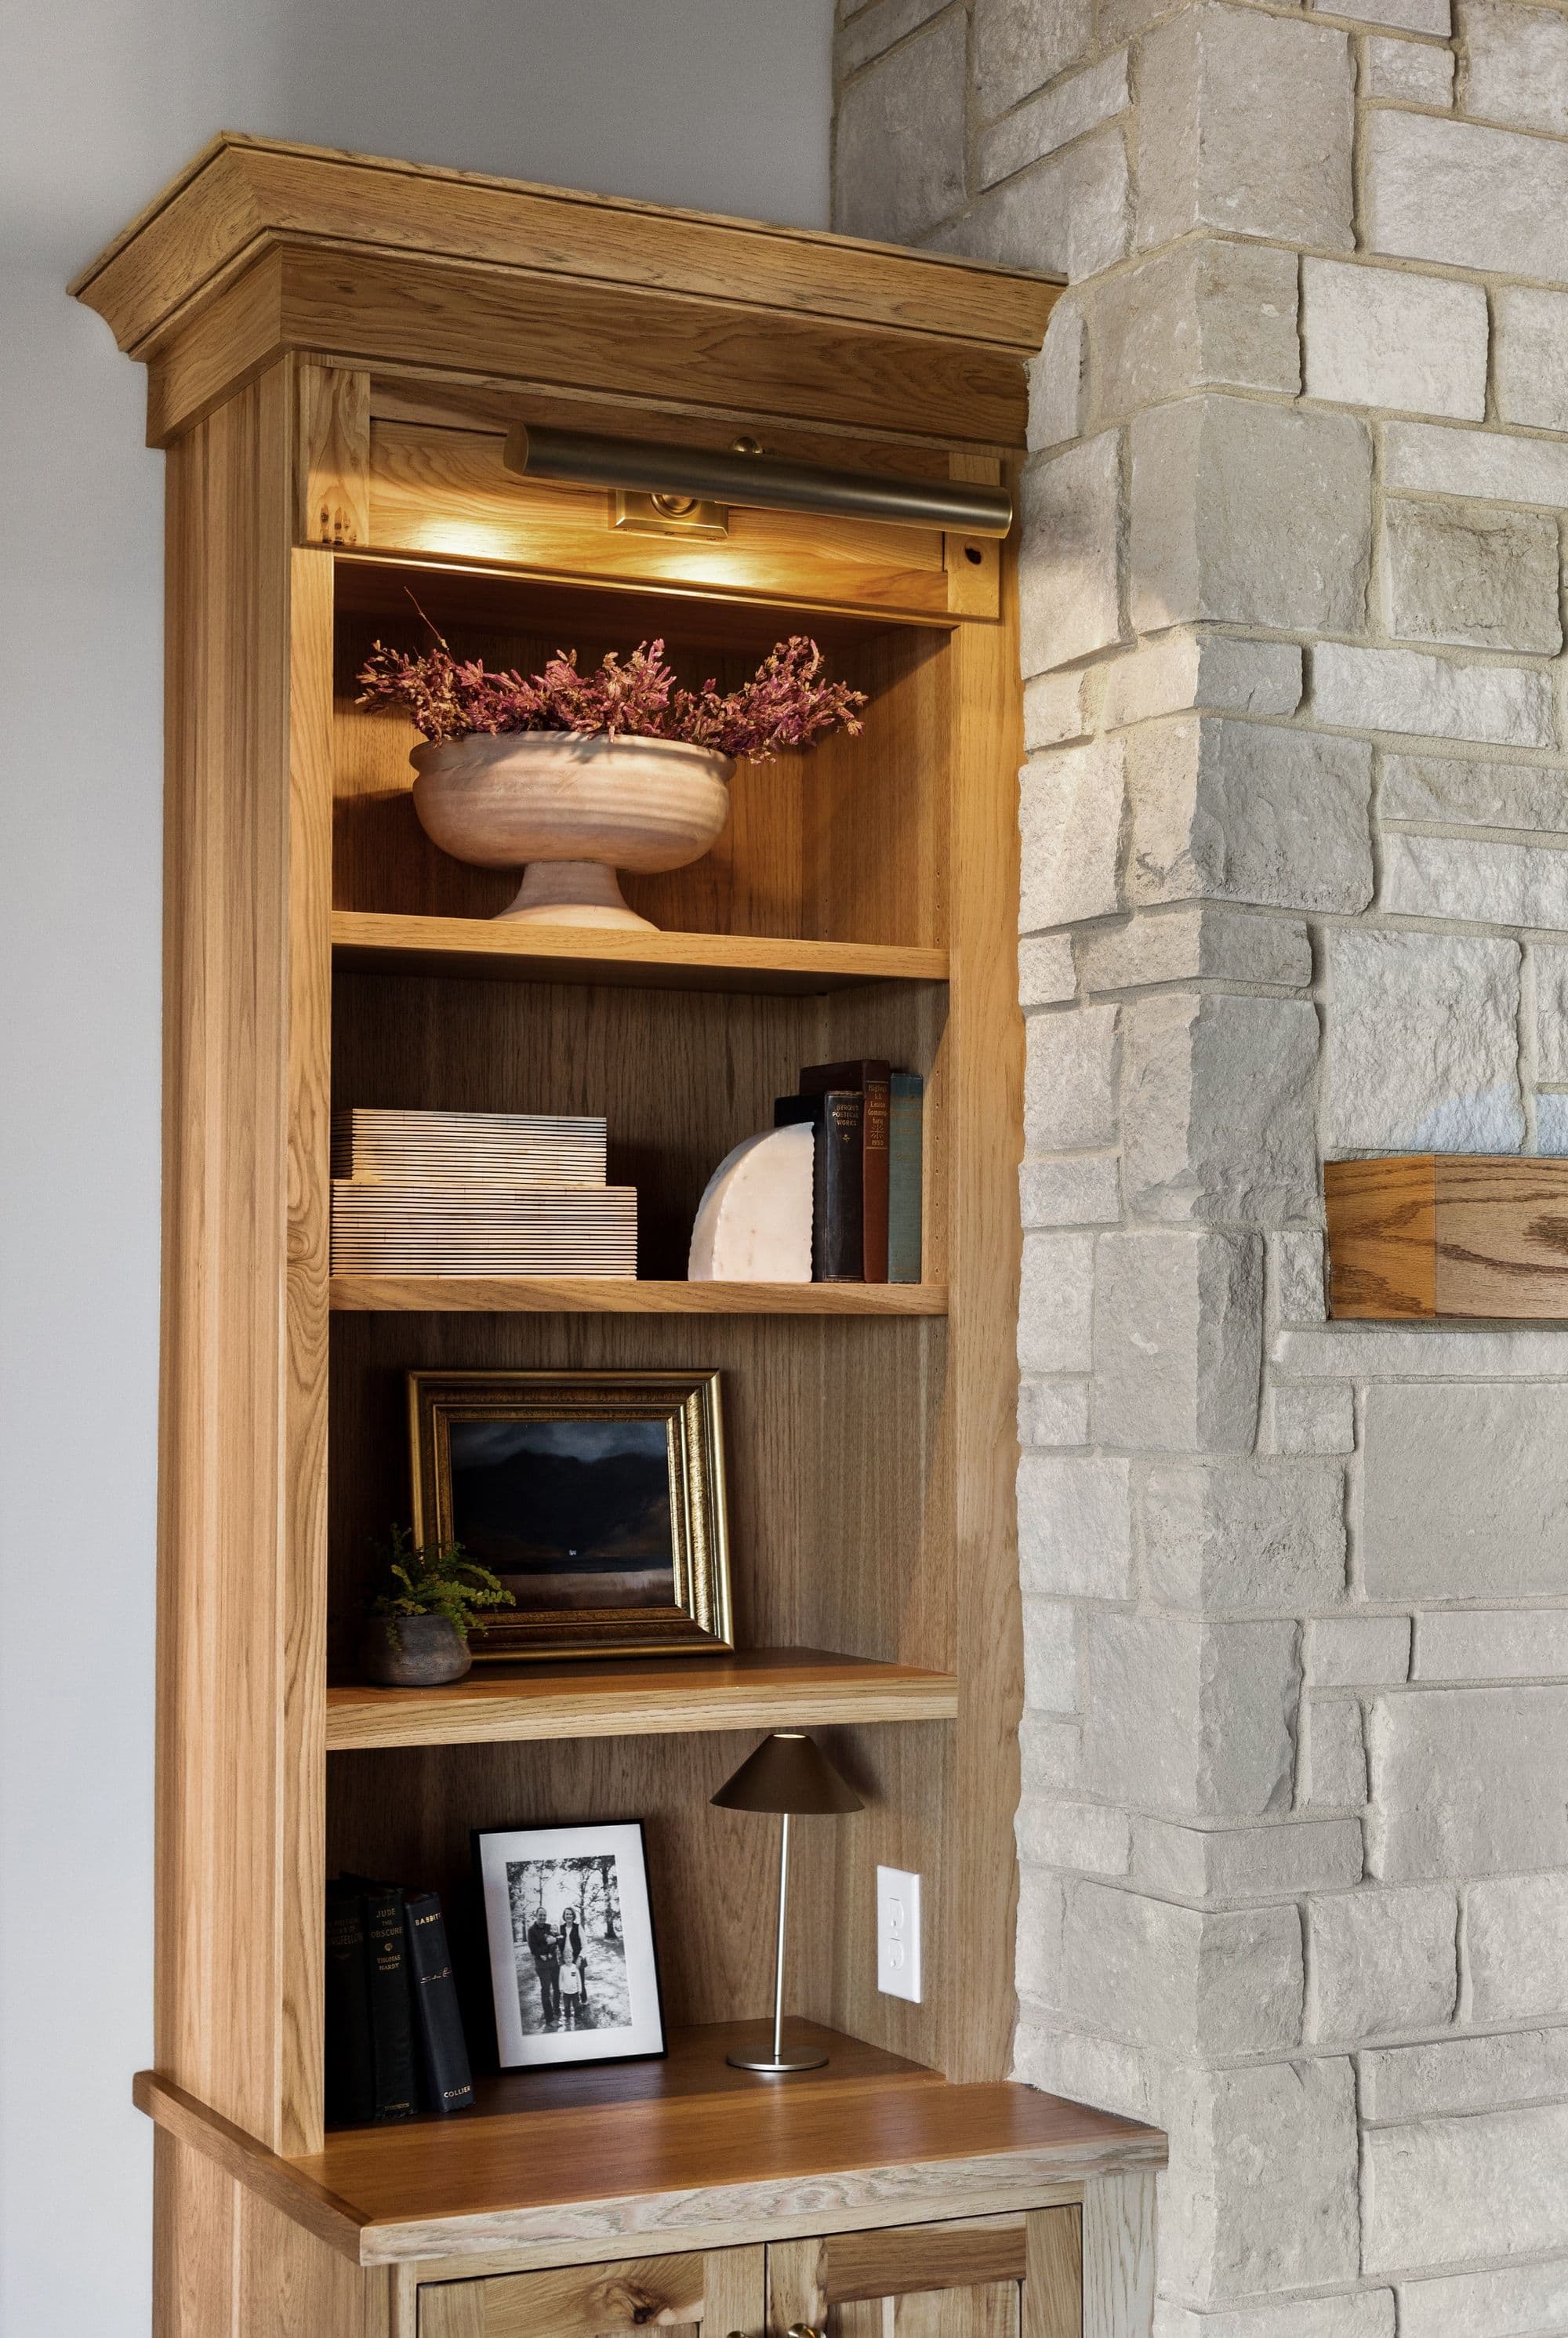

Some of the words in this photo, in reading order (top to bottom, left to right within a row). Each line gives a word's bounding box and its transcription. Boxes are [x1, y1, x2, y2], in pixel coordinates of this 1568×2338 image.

[376, 1908, 396, 1919] JUDE
[370, 1926, 403, 1939] OBSCURE
[376, 1955, 401, 1964] THOMAS
[379, 1962, 400, 1971] HARDY
[443, 2086, 471, 2098] COLLIER
